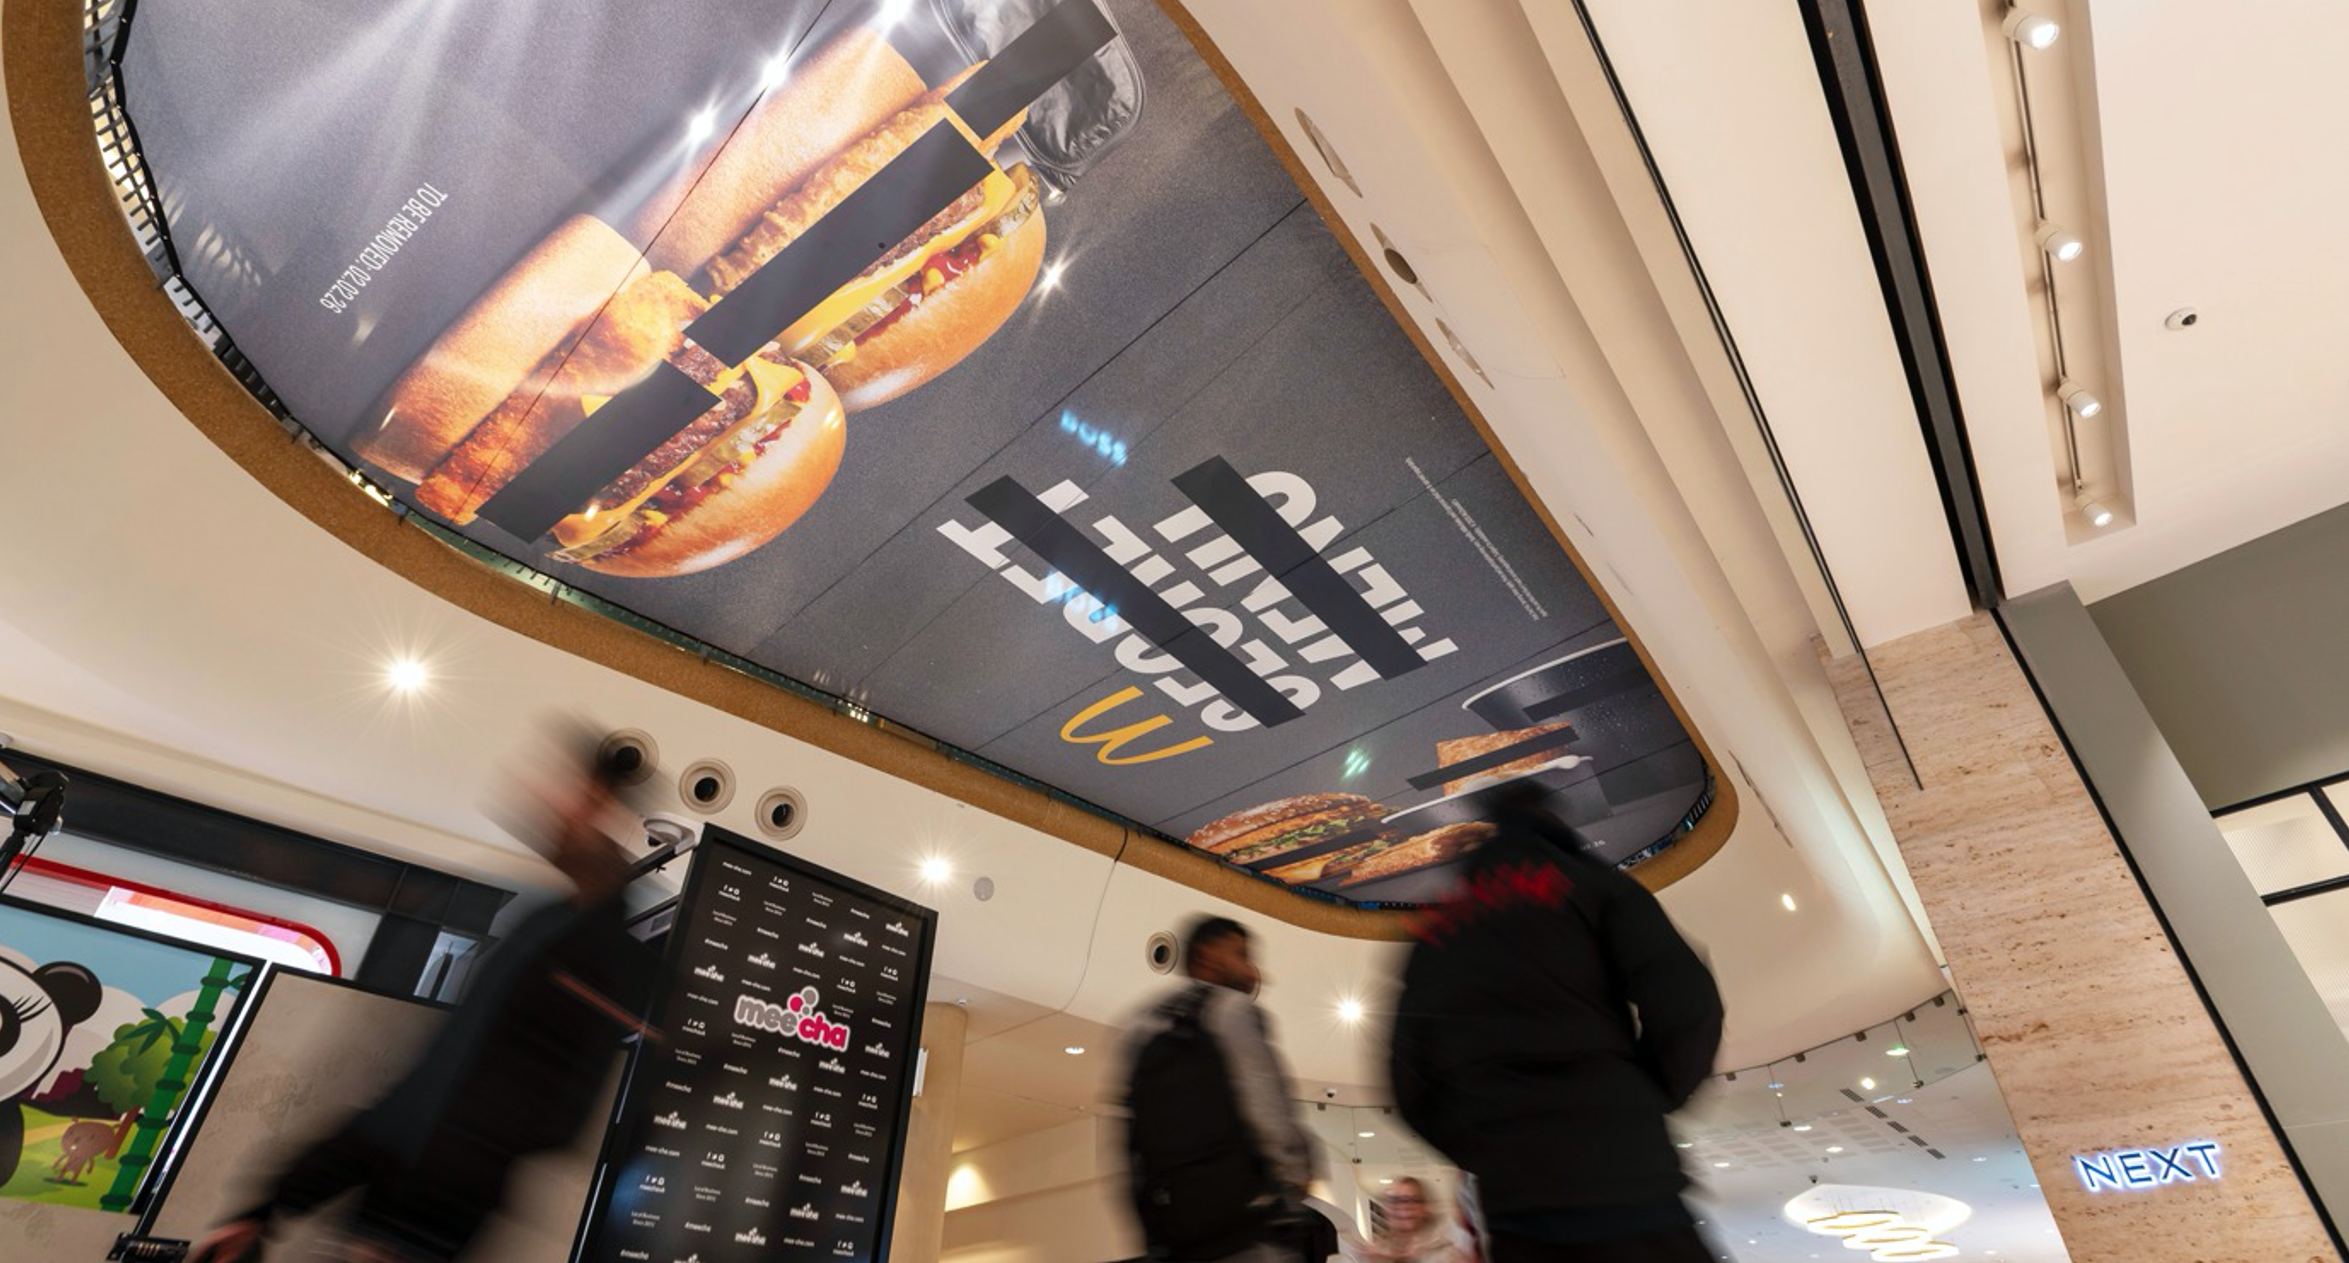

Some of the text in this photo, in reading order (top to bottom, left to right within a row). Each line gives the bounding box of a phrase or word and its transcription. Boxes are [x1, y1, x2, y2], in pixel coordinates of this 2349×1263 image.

[402, 198, 433, 224] BE
[416, 181, 449, 207] TO
[320, 264, 372, 314] 02.02.26
[936, 478, 1322, 732] SECRET
[1152, 470, 1460, 691] MENU
[2078, 1142, 2218, 1190] NEXT
